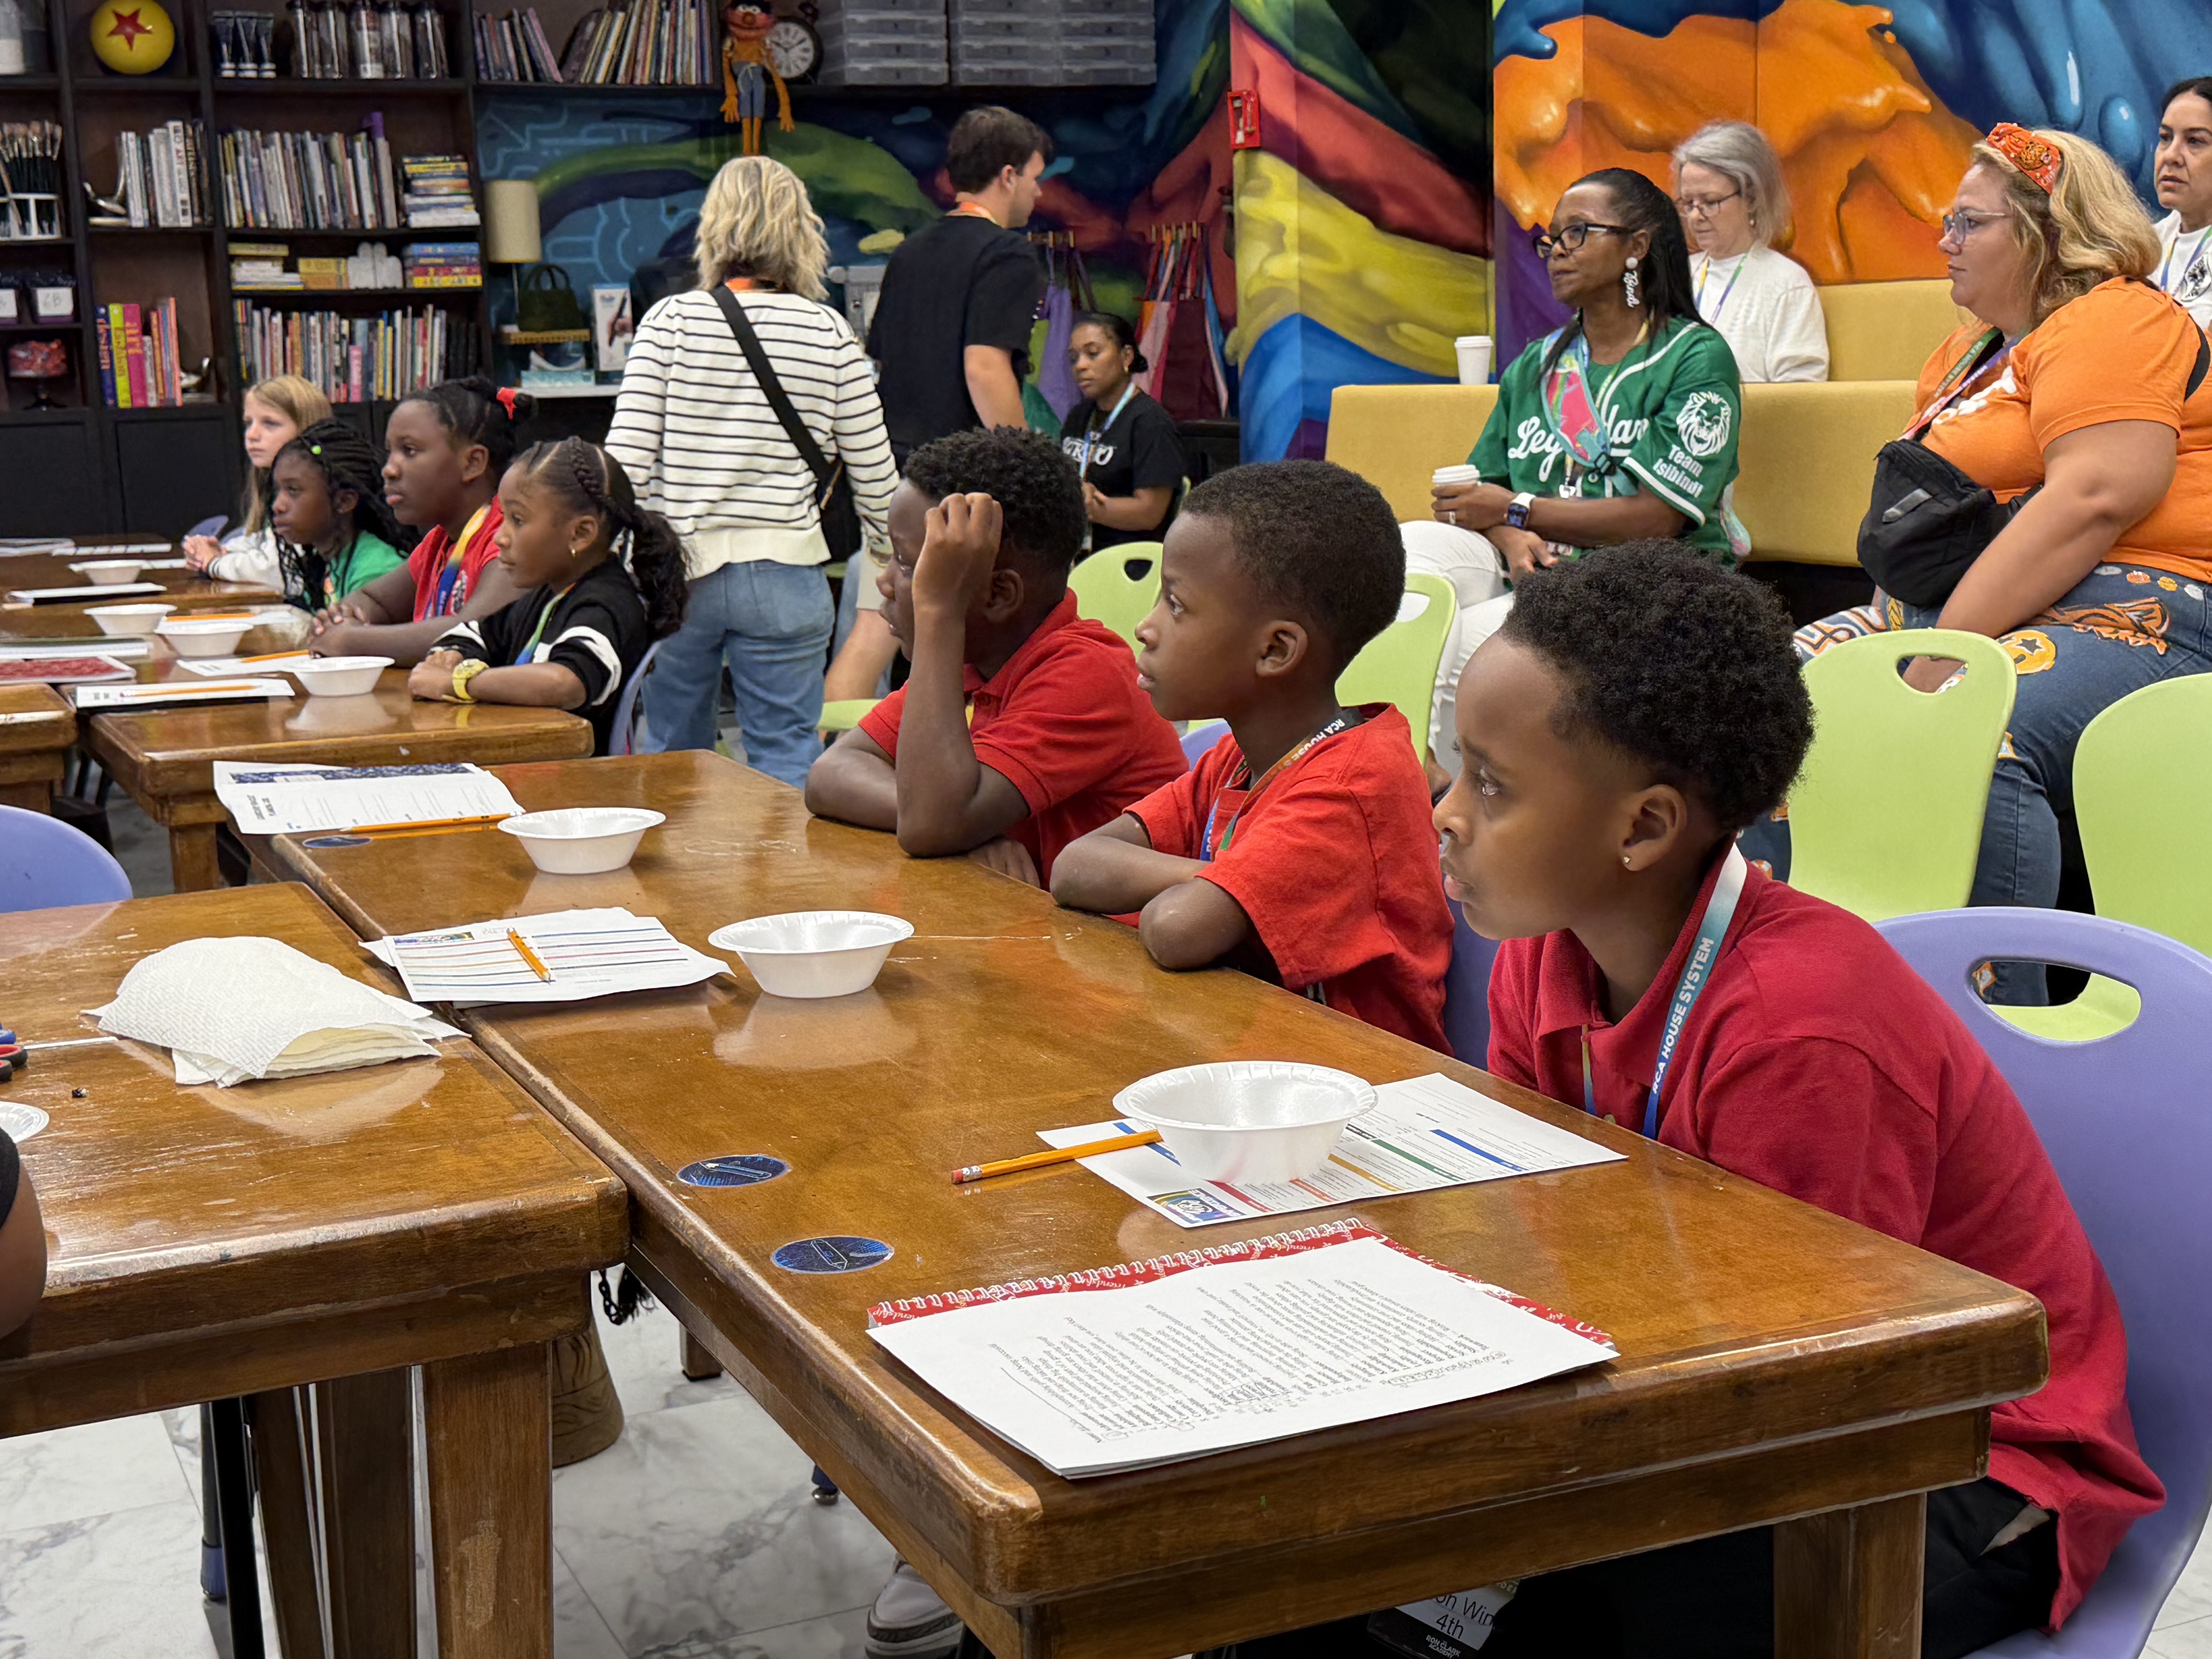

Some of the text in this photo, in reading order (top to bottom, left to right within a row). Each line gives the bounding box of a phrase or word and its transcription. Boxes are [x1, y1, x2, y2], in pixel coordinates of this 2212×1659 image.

[1668, 444, 1704, 477] Team
[1652, 458, 1704, 498] Isibindi
[1324, 719, 1345, 735] RCA
[1652, 937, 1715, 1094] RCA HOUSE SYSTEM
[1436, 1613, 1464, 1640] 4th
[1425, 1634, 1462, 1657] RON CLARK
